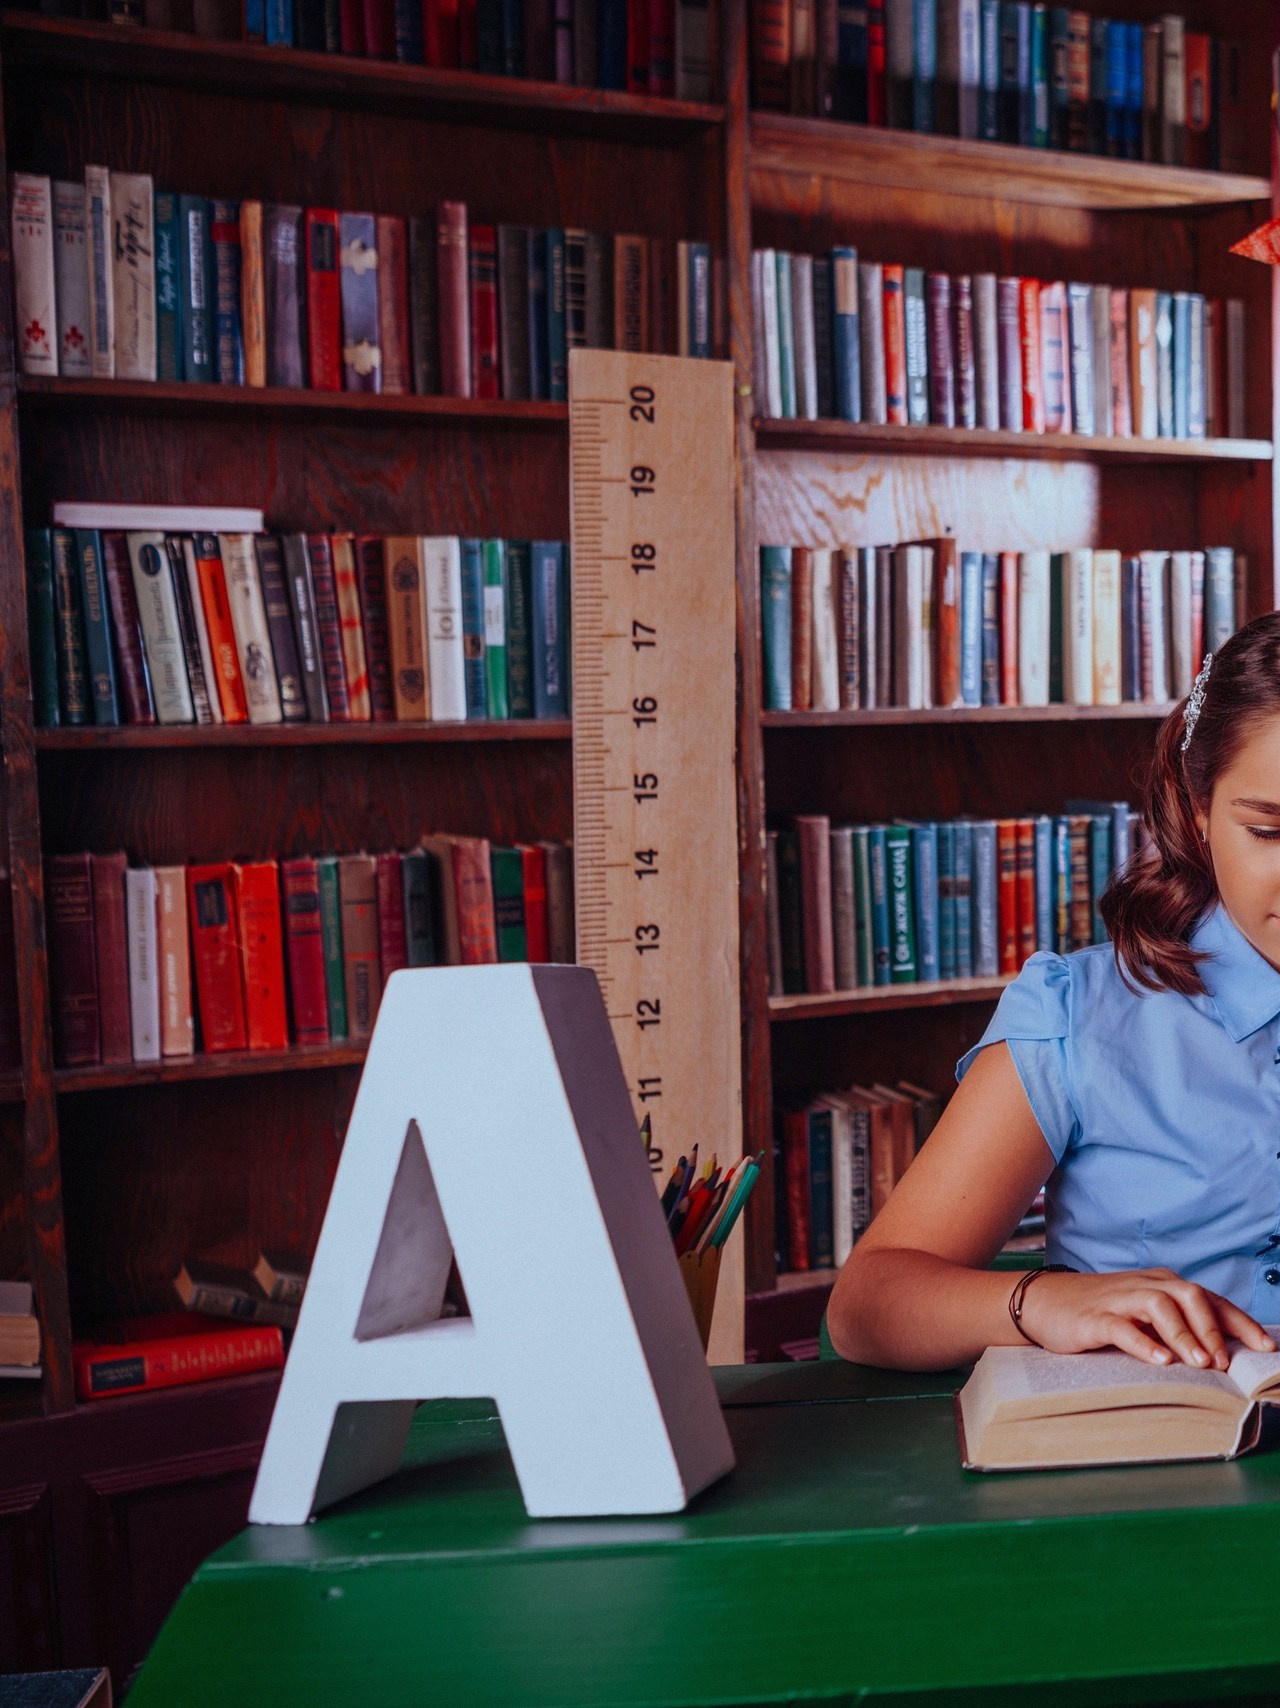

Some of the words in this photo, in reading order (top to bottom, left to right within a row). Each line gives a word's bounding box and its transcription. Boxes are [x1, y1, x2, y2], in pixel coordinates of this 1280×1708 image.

[630, 385, 656, 423] 20
[630, 465, 656, 497] 19
[631, 542, 657, 574] 18
[632, 620, 657, 651] 17
[633, 696, 658, 728] 16
[634, 773, 659, 804] 15
[635, 848, 659, 880] 14
[635, 924, 660, 955] 13
[636, 998, 661, 1030] 12
[638, 1076, 662, 1102] 11
